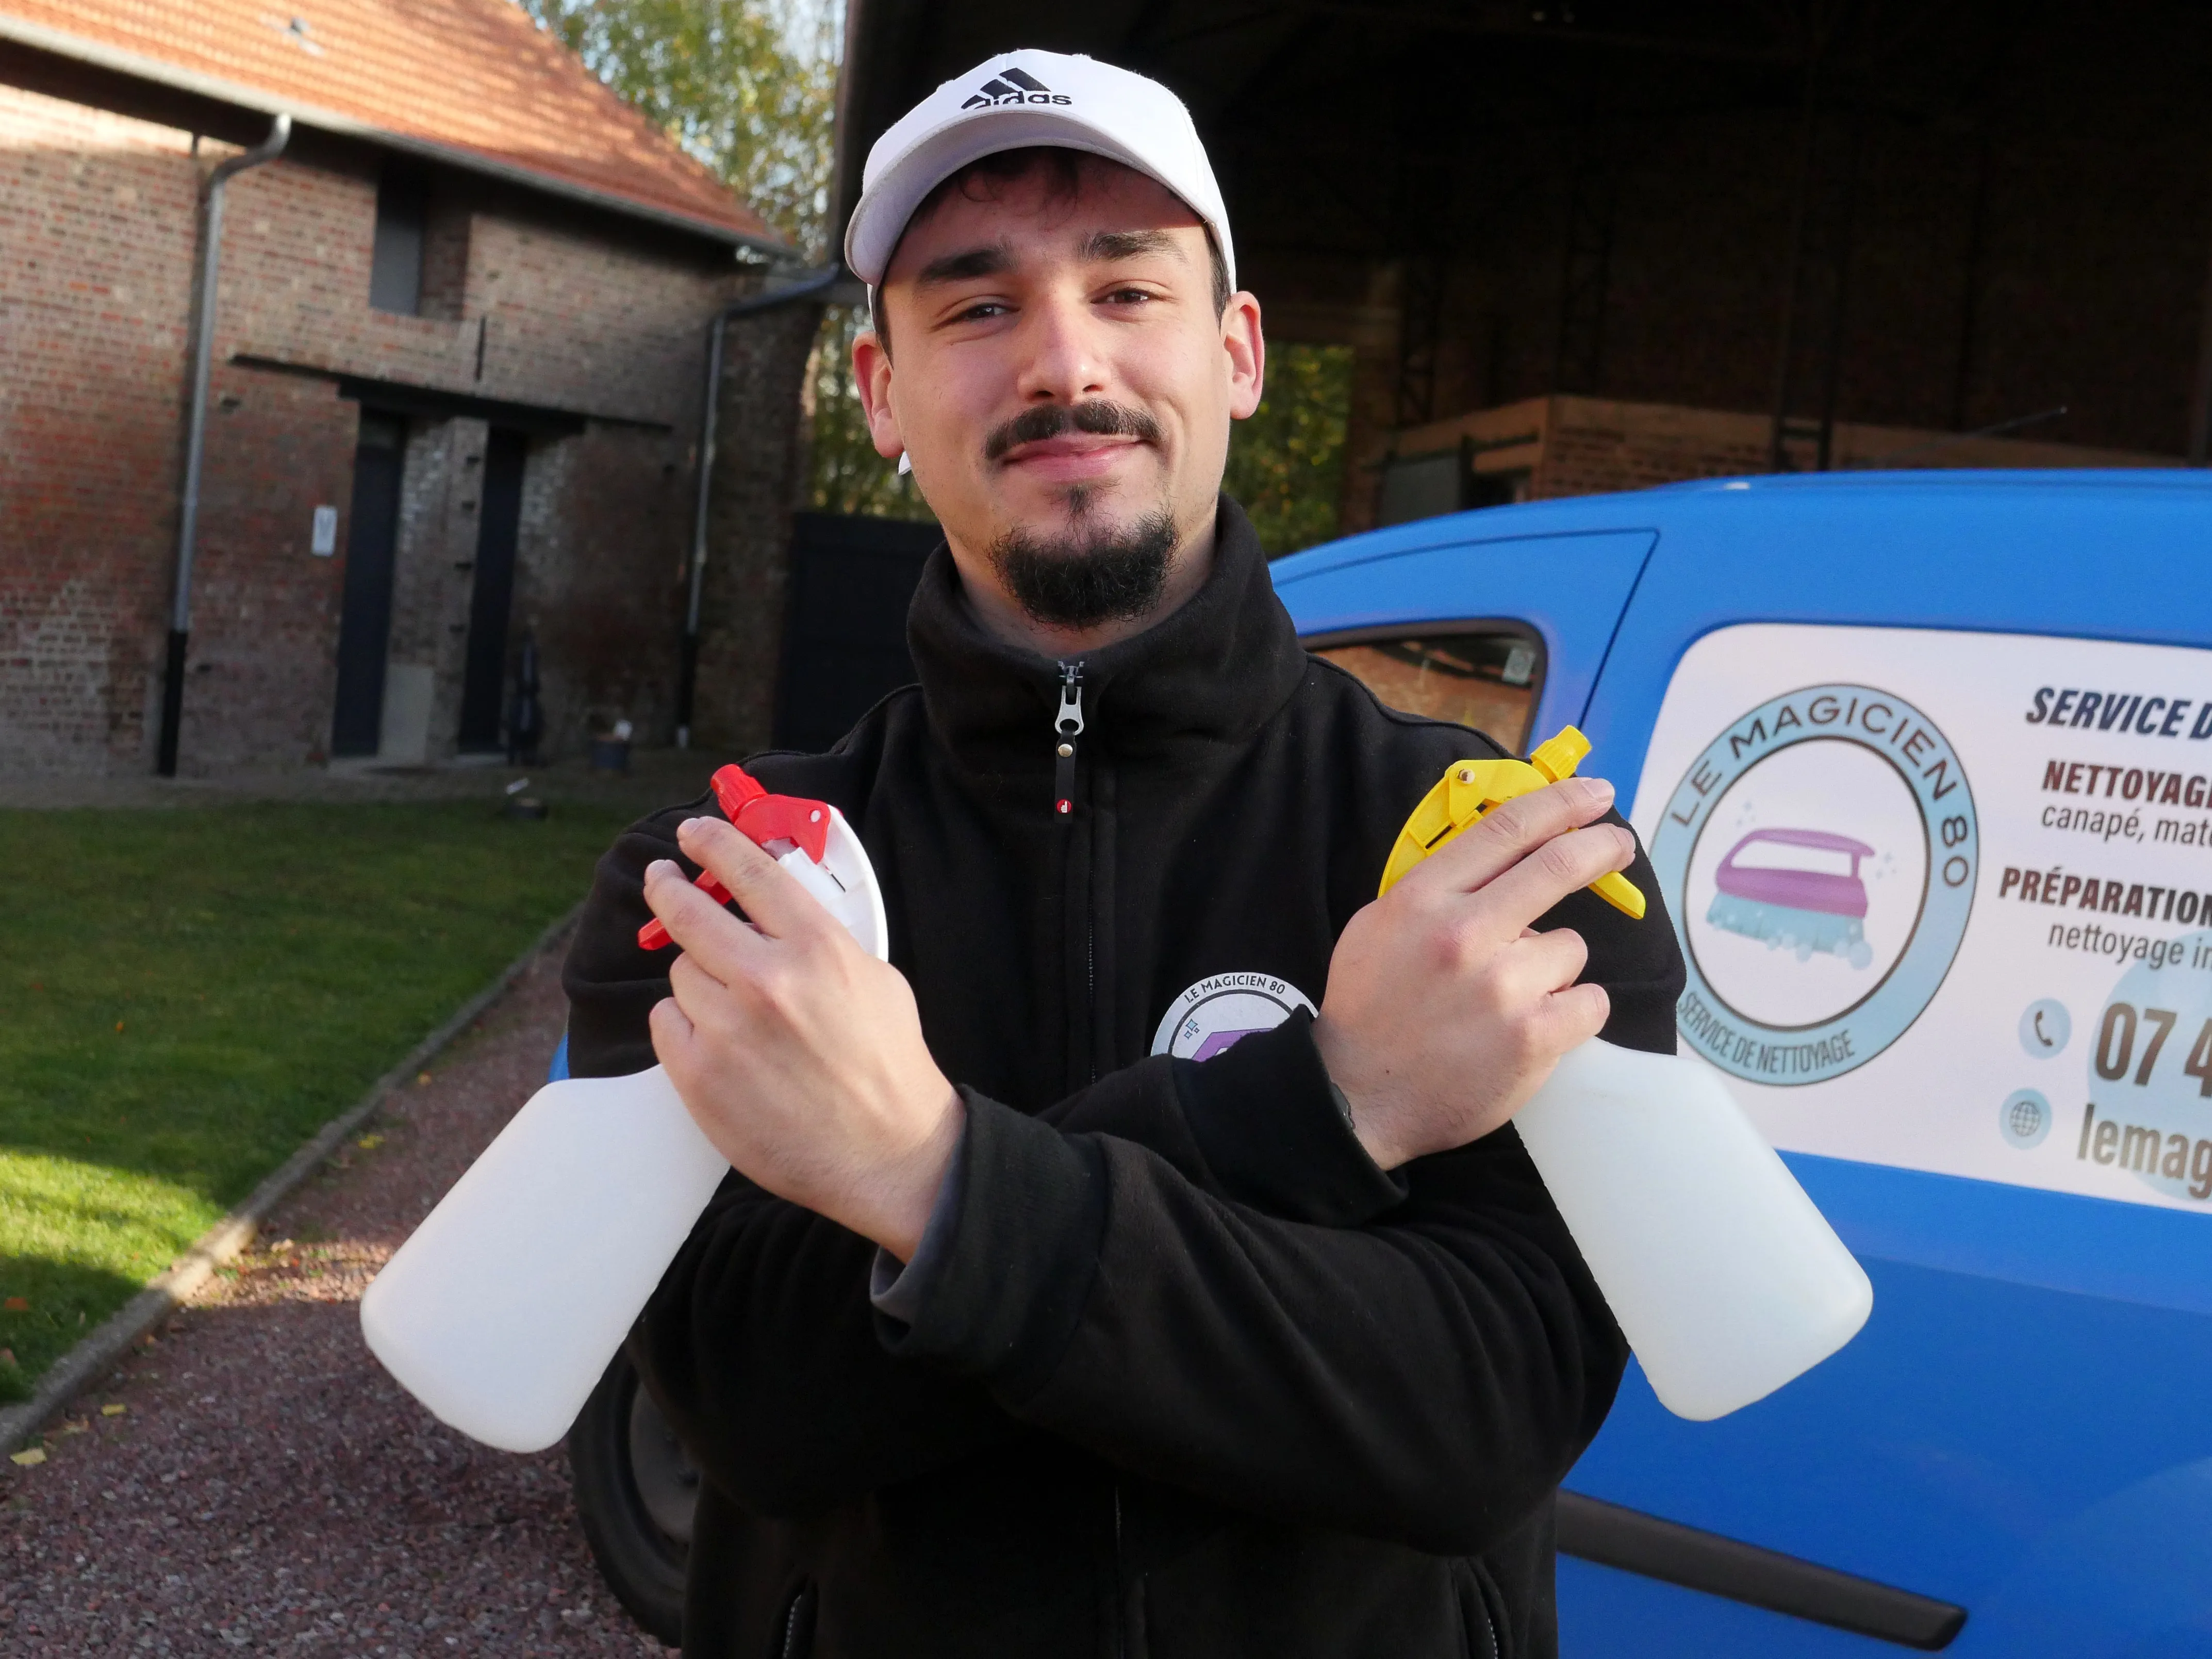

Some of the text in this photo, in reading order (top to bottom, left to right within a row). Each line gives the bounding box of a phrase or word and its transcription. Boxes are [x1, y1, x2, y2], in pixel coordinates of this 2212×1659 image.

[2026, 686, 2192, 737] SERVICE
[1671, 695, 1970, 888] LE MAGICIEN 80
[2041, 806, 2212, 847] canapé, mat
[1998, 865, 2212, 926] PRÉPARATION
[2048, 922, 2184, 971] nettoyage
[1184, 975, 1285, 1003] LE MAGICIEN 80
[1679, 991, 1855, 1074] SERVICE DE NETTOYAGE
[2095, 1002, 2212, 1097] 07 4
[2077, 1103, 2212, 1200] lemag
